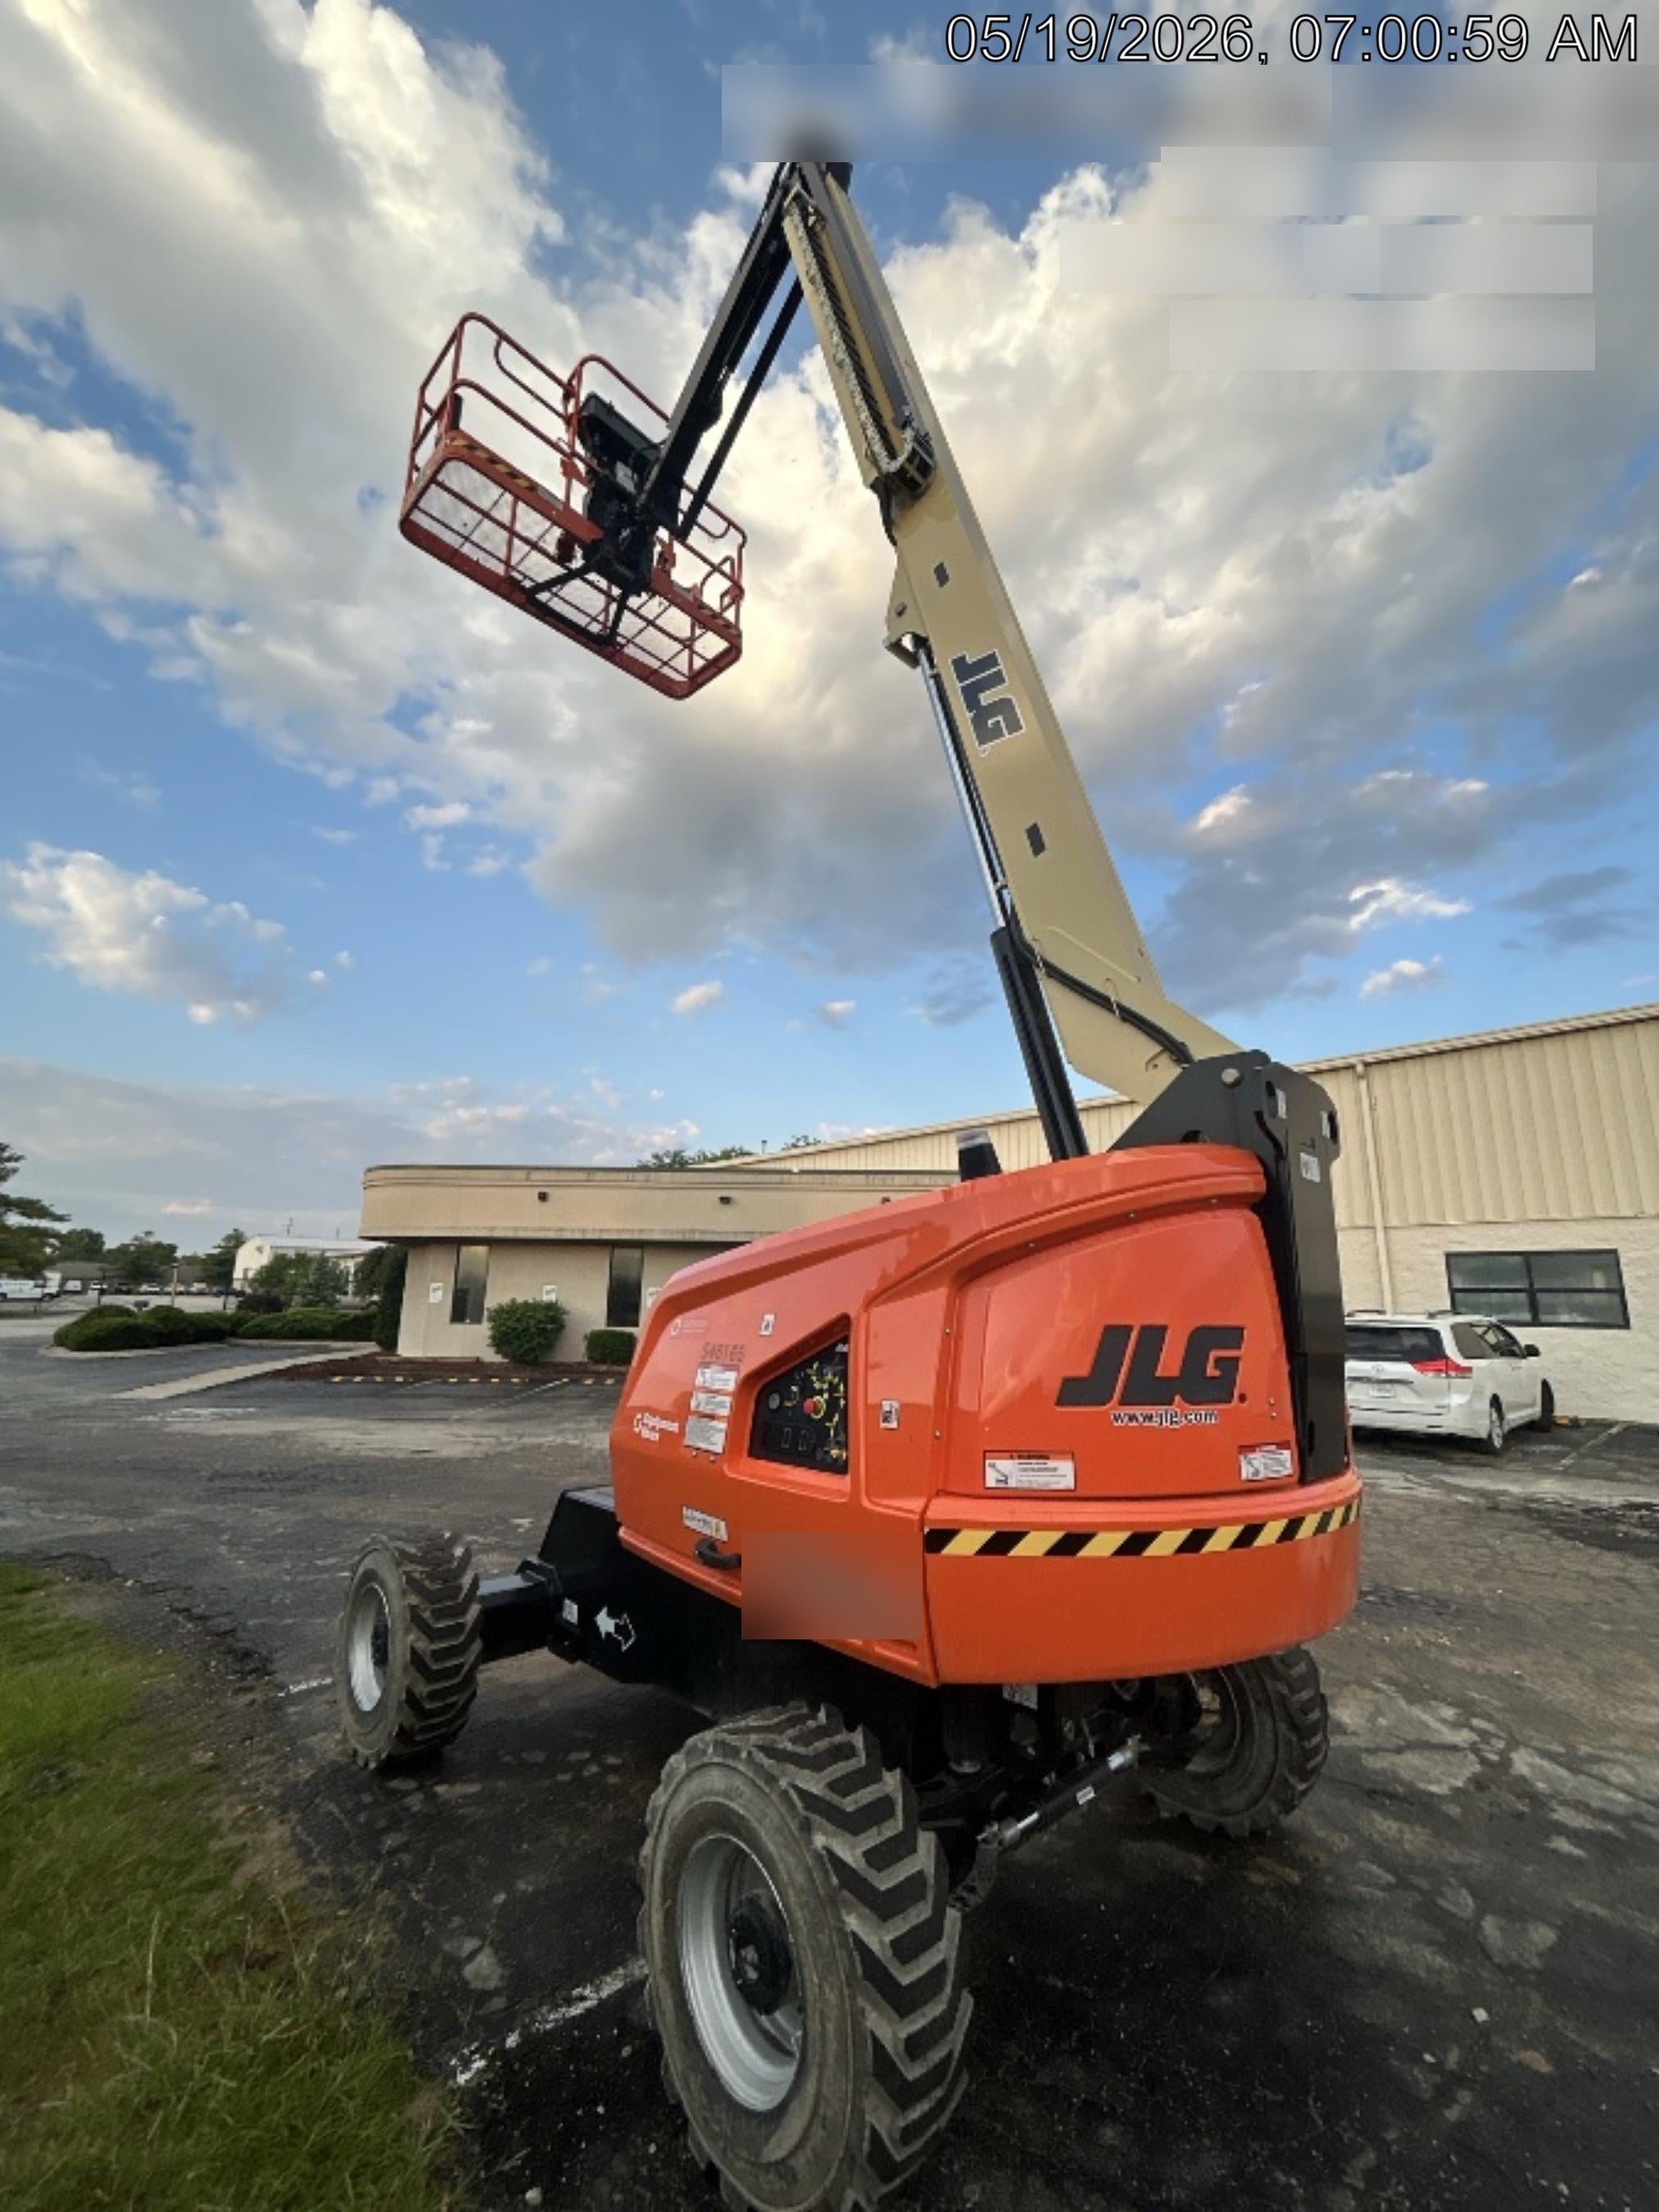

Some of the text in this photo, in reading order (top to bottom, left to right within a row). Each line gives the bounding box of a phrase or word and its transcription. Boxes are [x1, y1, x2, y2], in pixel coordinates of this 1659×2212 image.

[950, 650, 1025, 749] JLG
[1054, 1324, 1246, 1407] JLG
[1111, 1407, 1218, 1428] www.jlg.com
